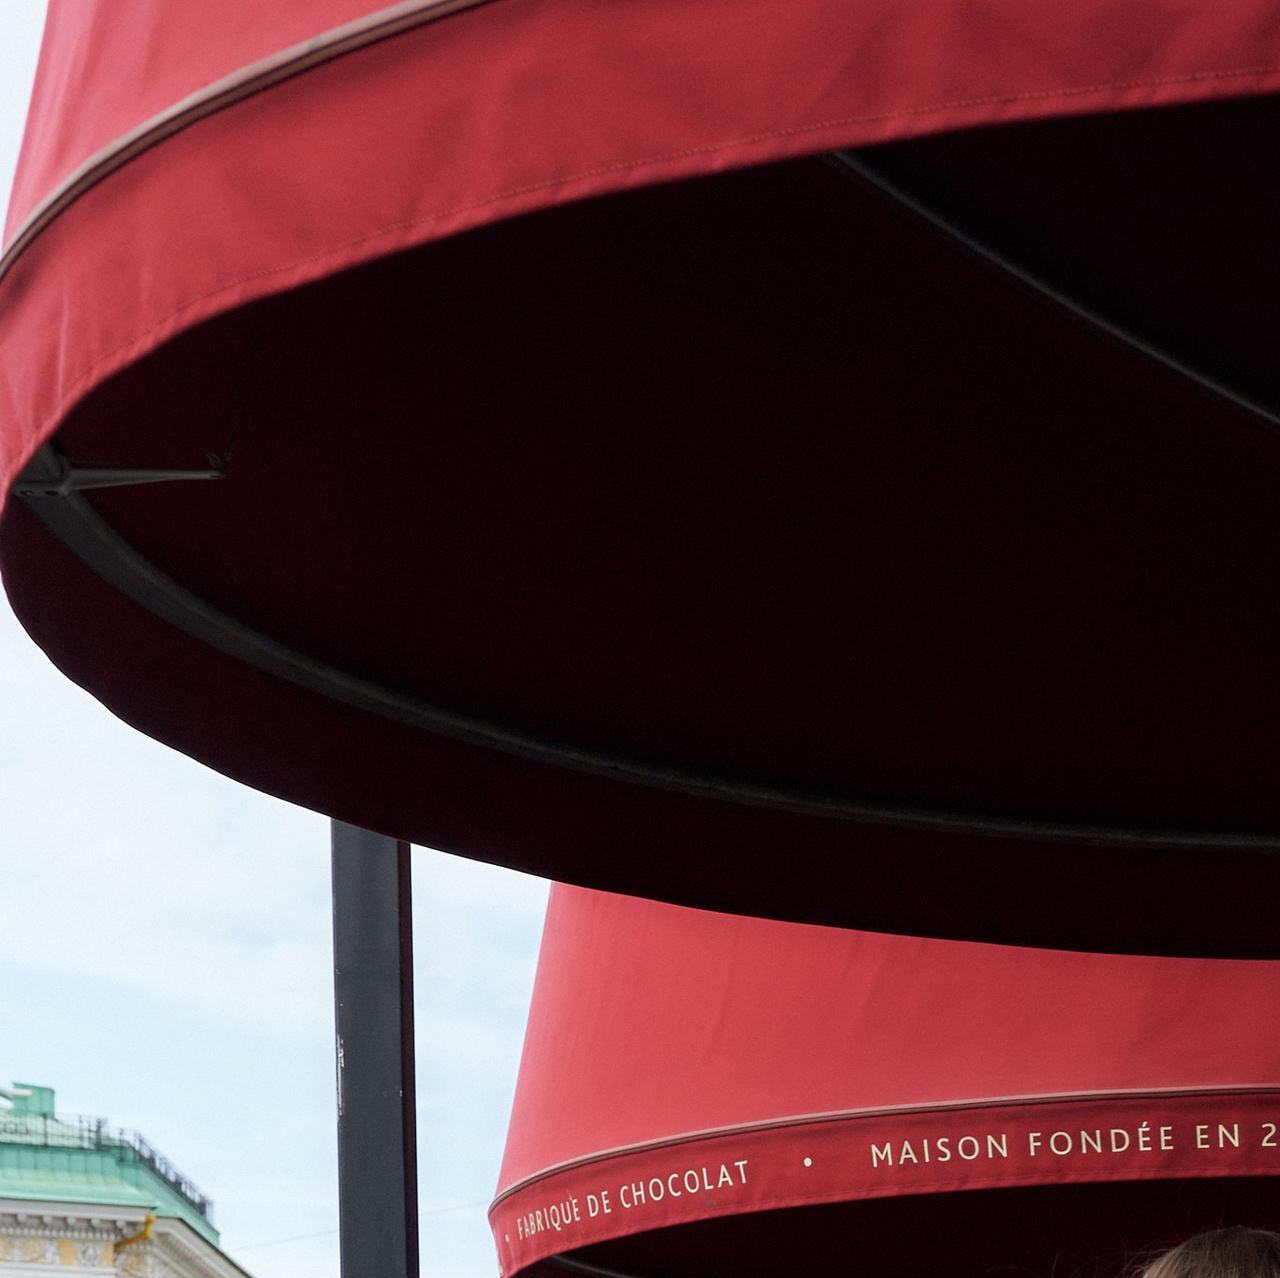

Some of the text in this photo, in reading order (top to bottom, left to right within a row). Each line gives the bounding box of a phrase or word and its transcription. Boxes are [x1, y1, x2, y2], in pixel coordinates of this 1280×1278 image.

[516, 1199, 581, 1241] FABRIQUE
[586, 1190, 612, 1218] DE
[620, 1161, 748, 1209] CHOCOLAT
[870, 1134, 1009, 1168] MAISON
[1029, 1122, 1174, 1156] FONDÉE
[1196, 1124, 1239, 1149] EN
